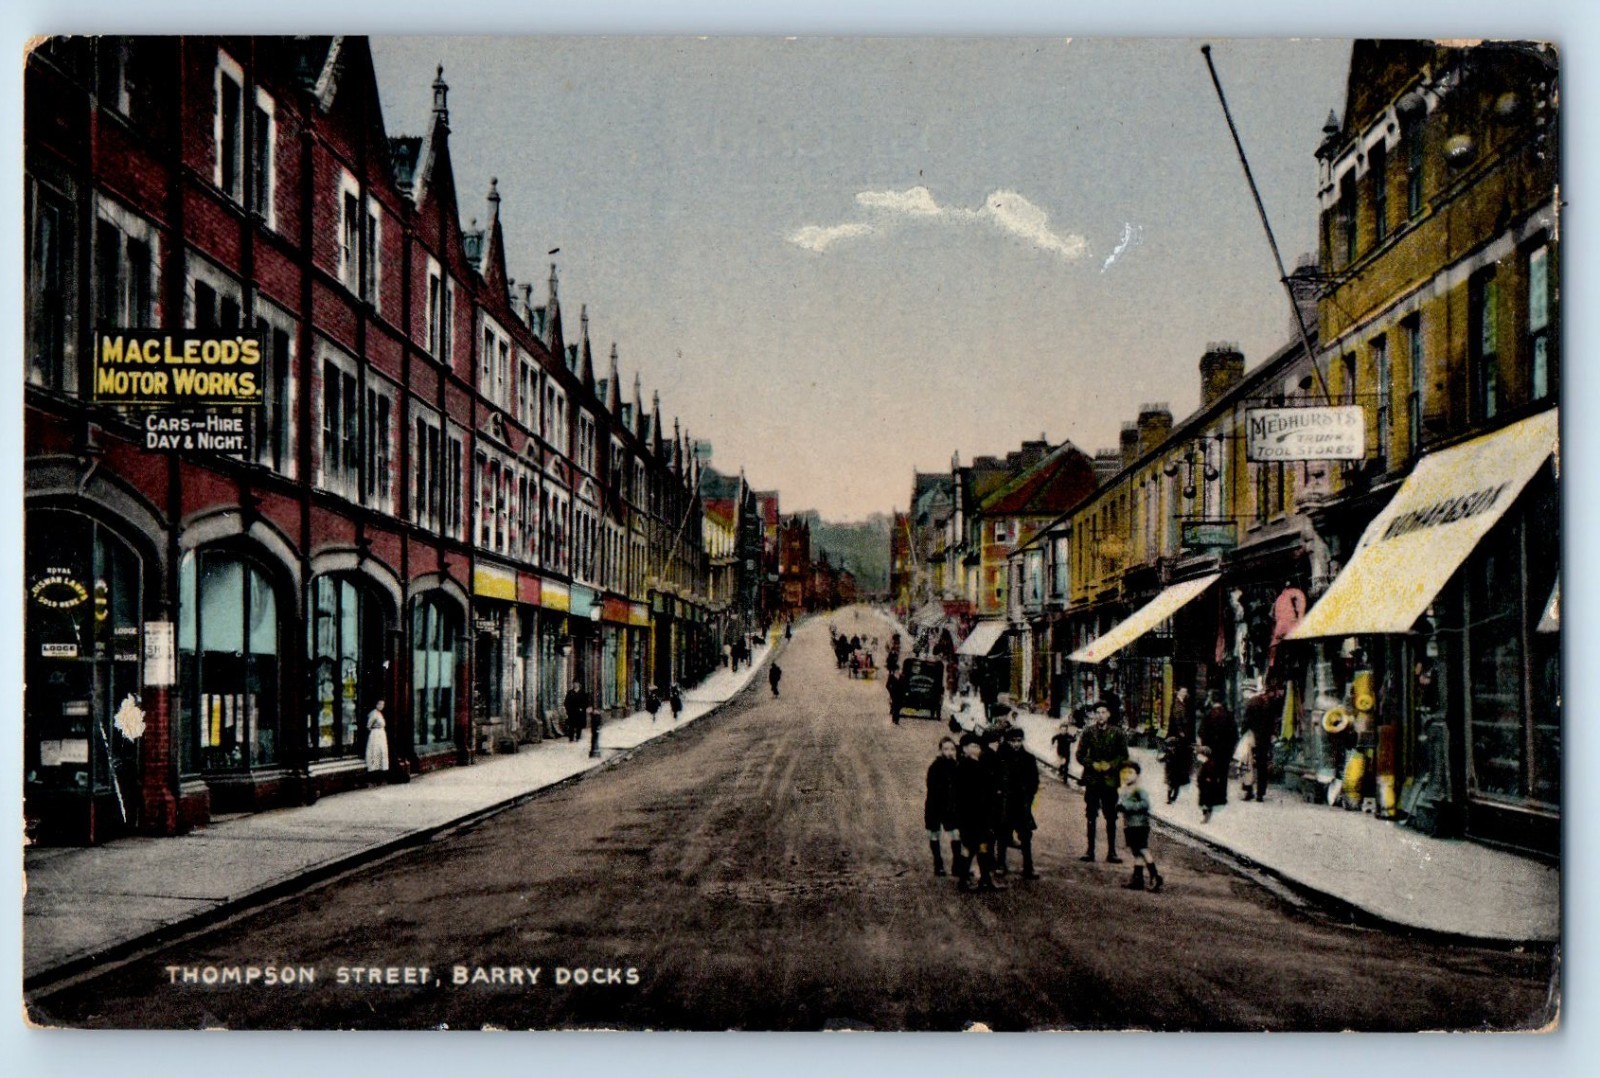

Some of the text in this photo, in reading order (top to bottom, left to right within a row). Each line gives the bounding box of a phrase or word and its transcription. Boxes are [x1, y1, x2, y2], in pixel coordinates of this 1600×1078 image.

[99, 367, 263, 395] MOTOR WORKS.
[146, 415, 190, 432] CARS
[206, 415, 244, 432] HIRE
[146, 432, 248, 450] DAY & NIGHT.
[1257, 445, 1354, 457] TOOL STORES
[46, 567, 72, 575] ROYAL
[114, 627, 137, 635] LODGE
